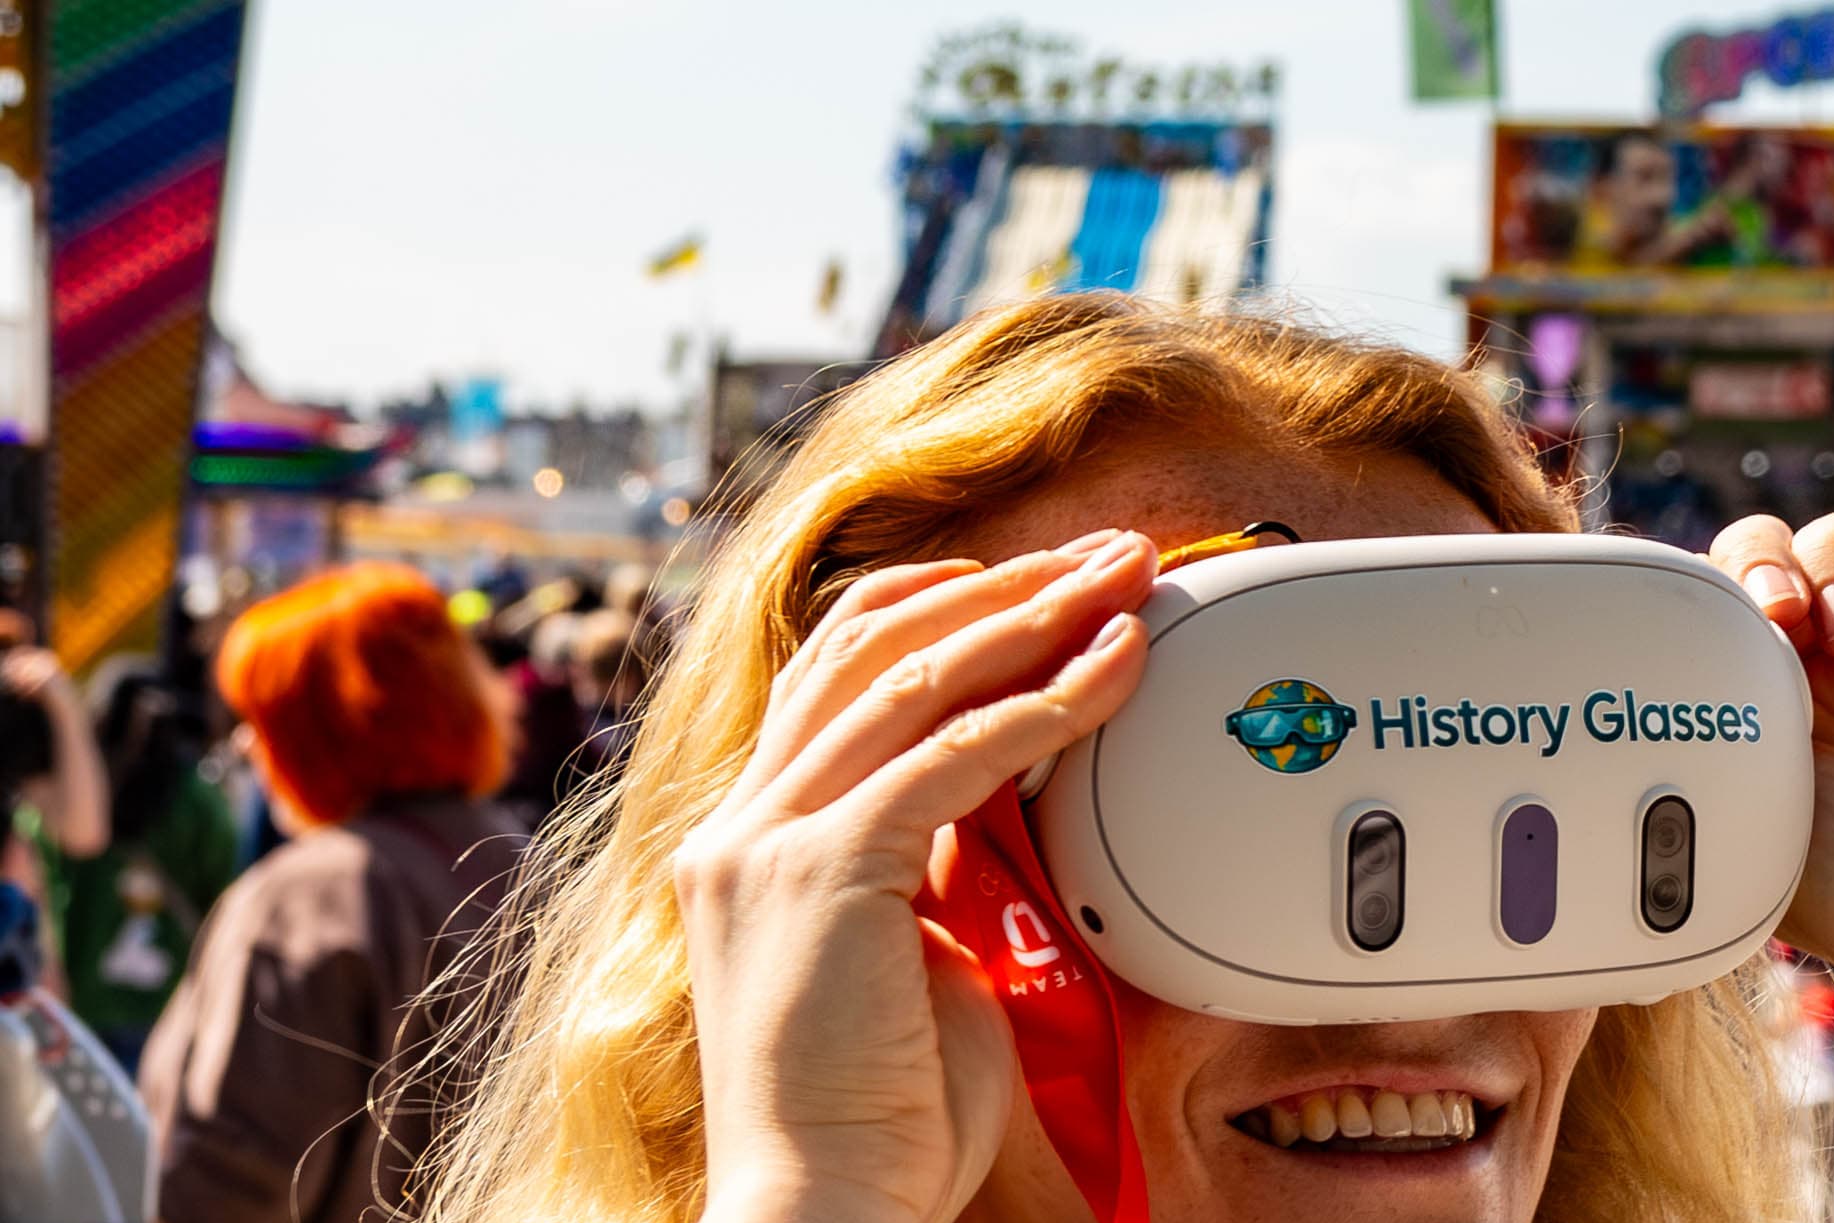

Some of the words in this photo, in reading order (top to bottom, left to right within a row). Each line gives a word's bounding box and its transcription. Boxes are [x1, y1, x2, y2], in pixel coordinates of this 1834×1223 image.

[1371, 696, 1570, 757] History
[1583, 689, 1761, 743] Glasses
[1009, 964, 1083, 996] TEAM
